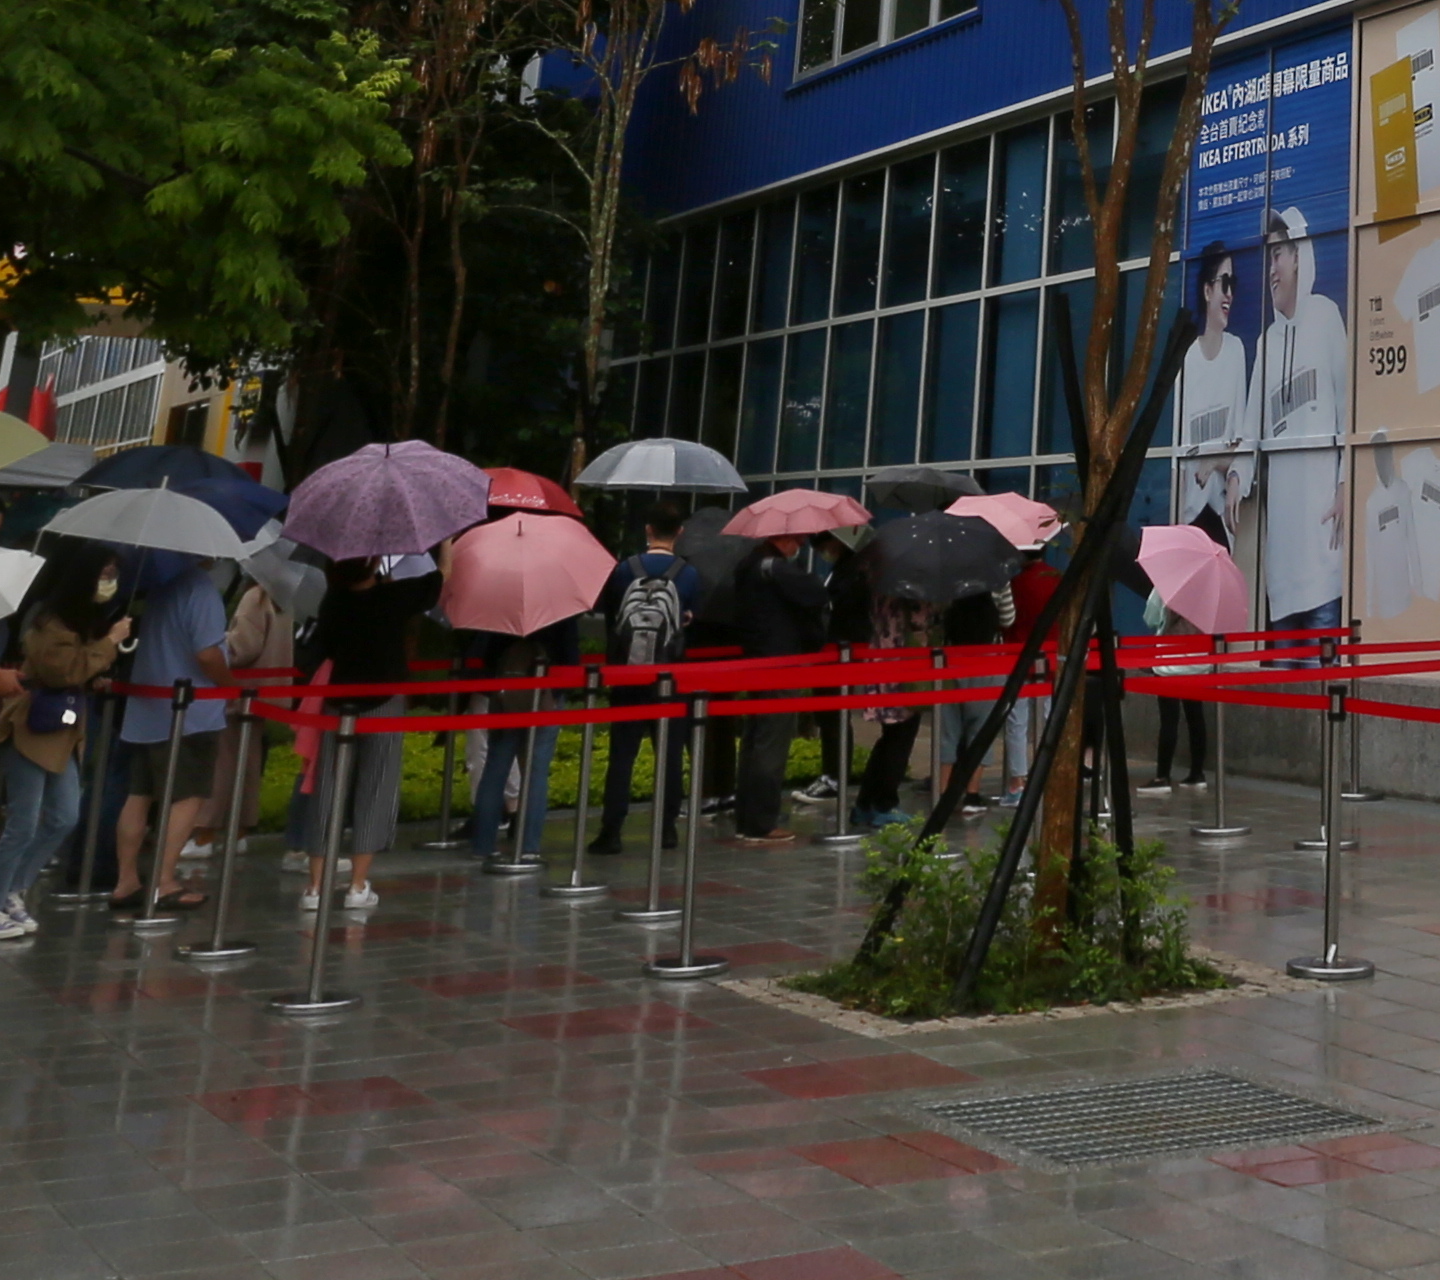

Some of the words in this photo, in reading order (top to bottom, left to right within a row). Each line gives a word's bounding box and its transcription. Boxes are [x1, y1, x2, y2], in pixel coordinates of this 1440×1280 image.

[1199, 148, 1221, 169] IKEA
[1287, 123, 1309, 149] 系列
[1369, 345, 1407, 376] $399
